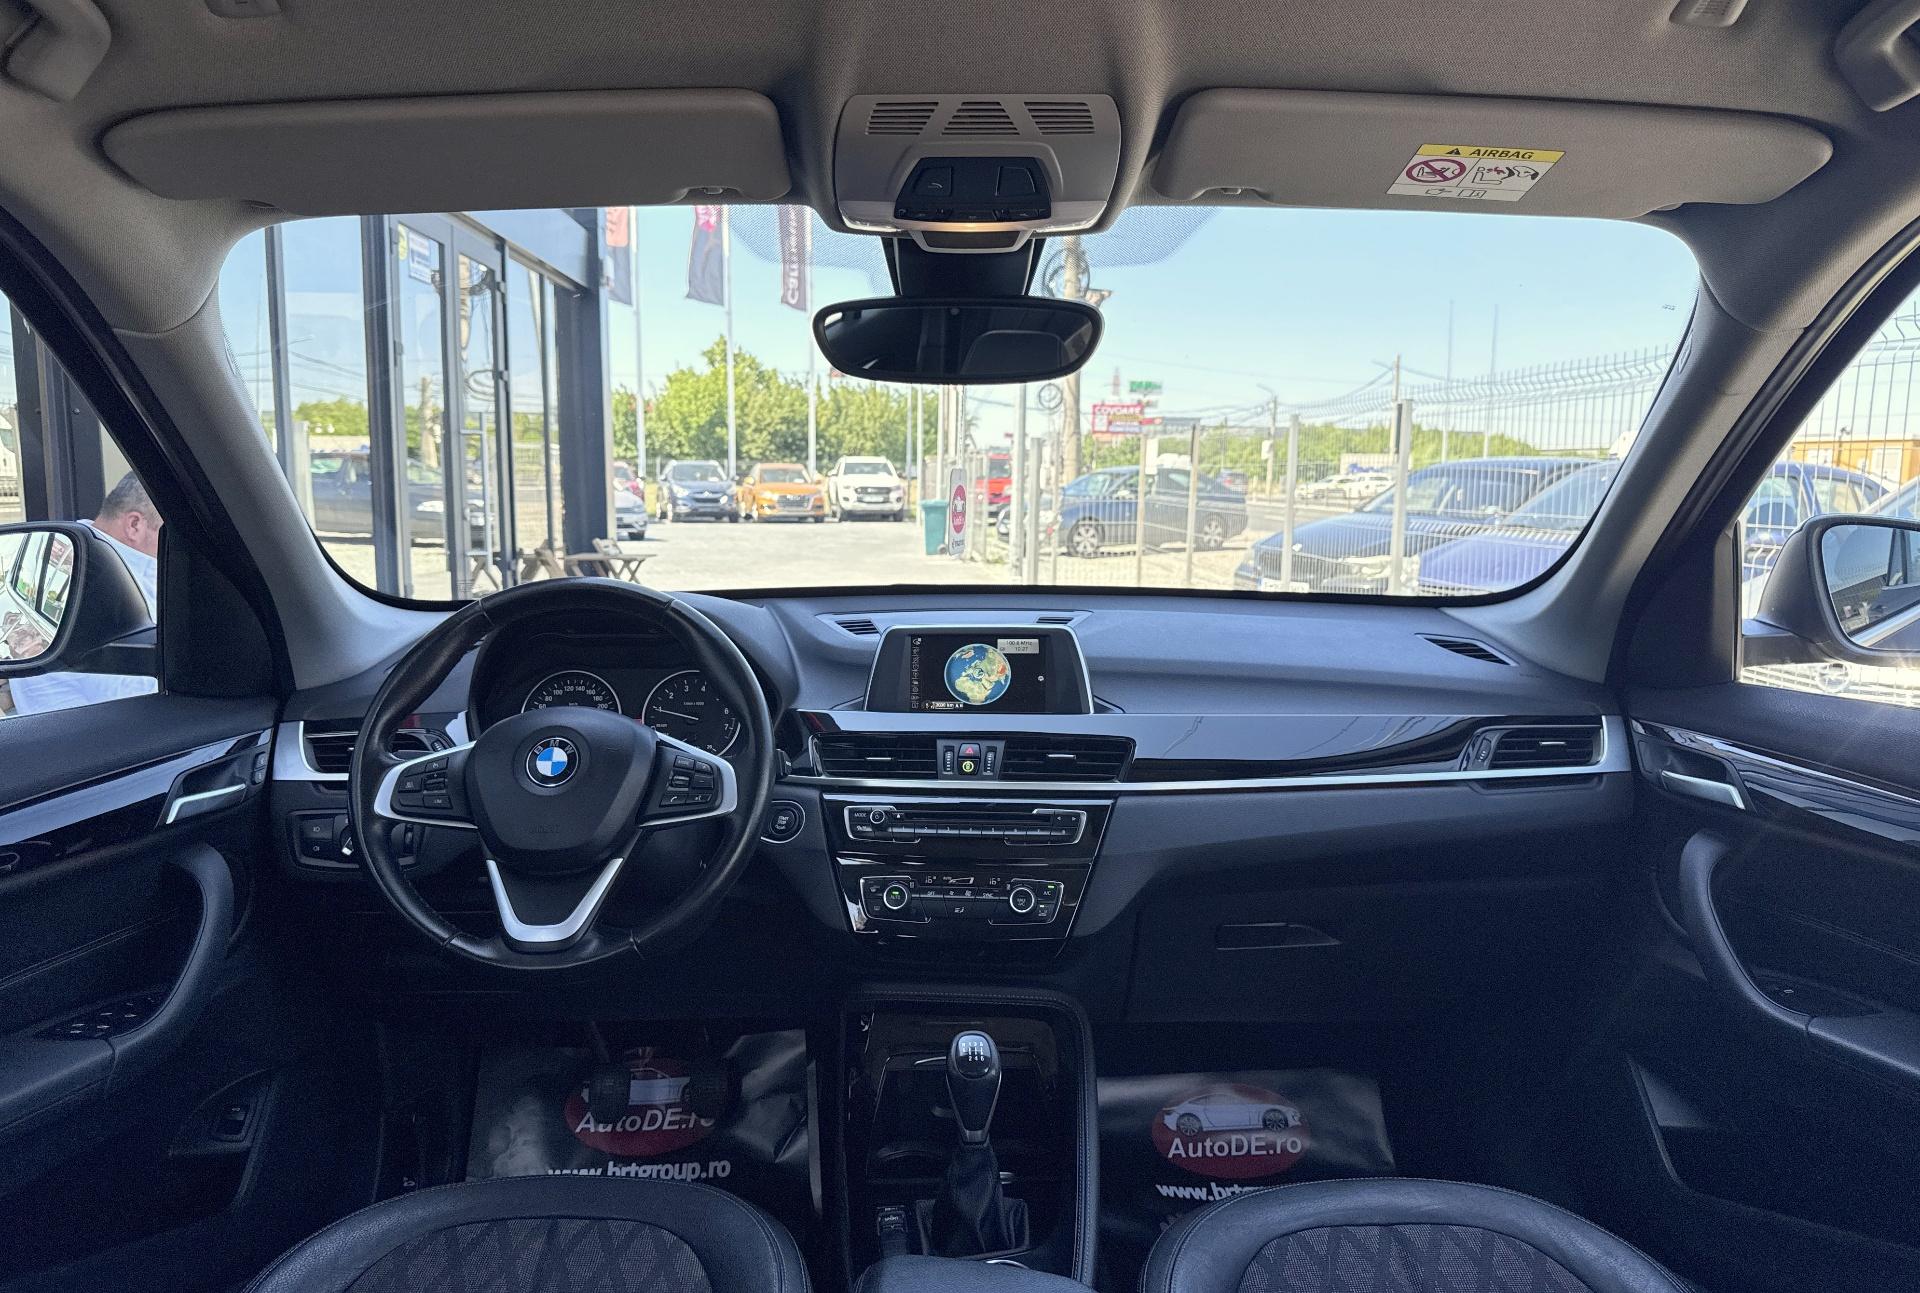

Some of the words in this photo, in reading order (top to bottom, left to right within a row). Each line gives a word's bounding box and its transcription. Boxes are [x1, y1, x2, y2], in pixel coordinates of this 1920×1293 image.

[1469, 148, 1534, 160] AIRBAG
[533, 739, 575, 755] BMW
[1167, 1134, 1302, 1159] AutoDE.ro
